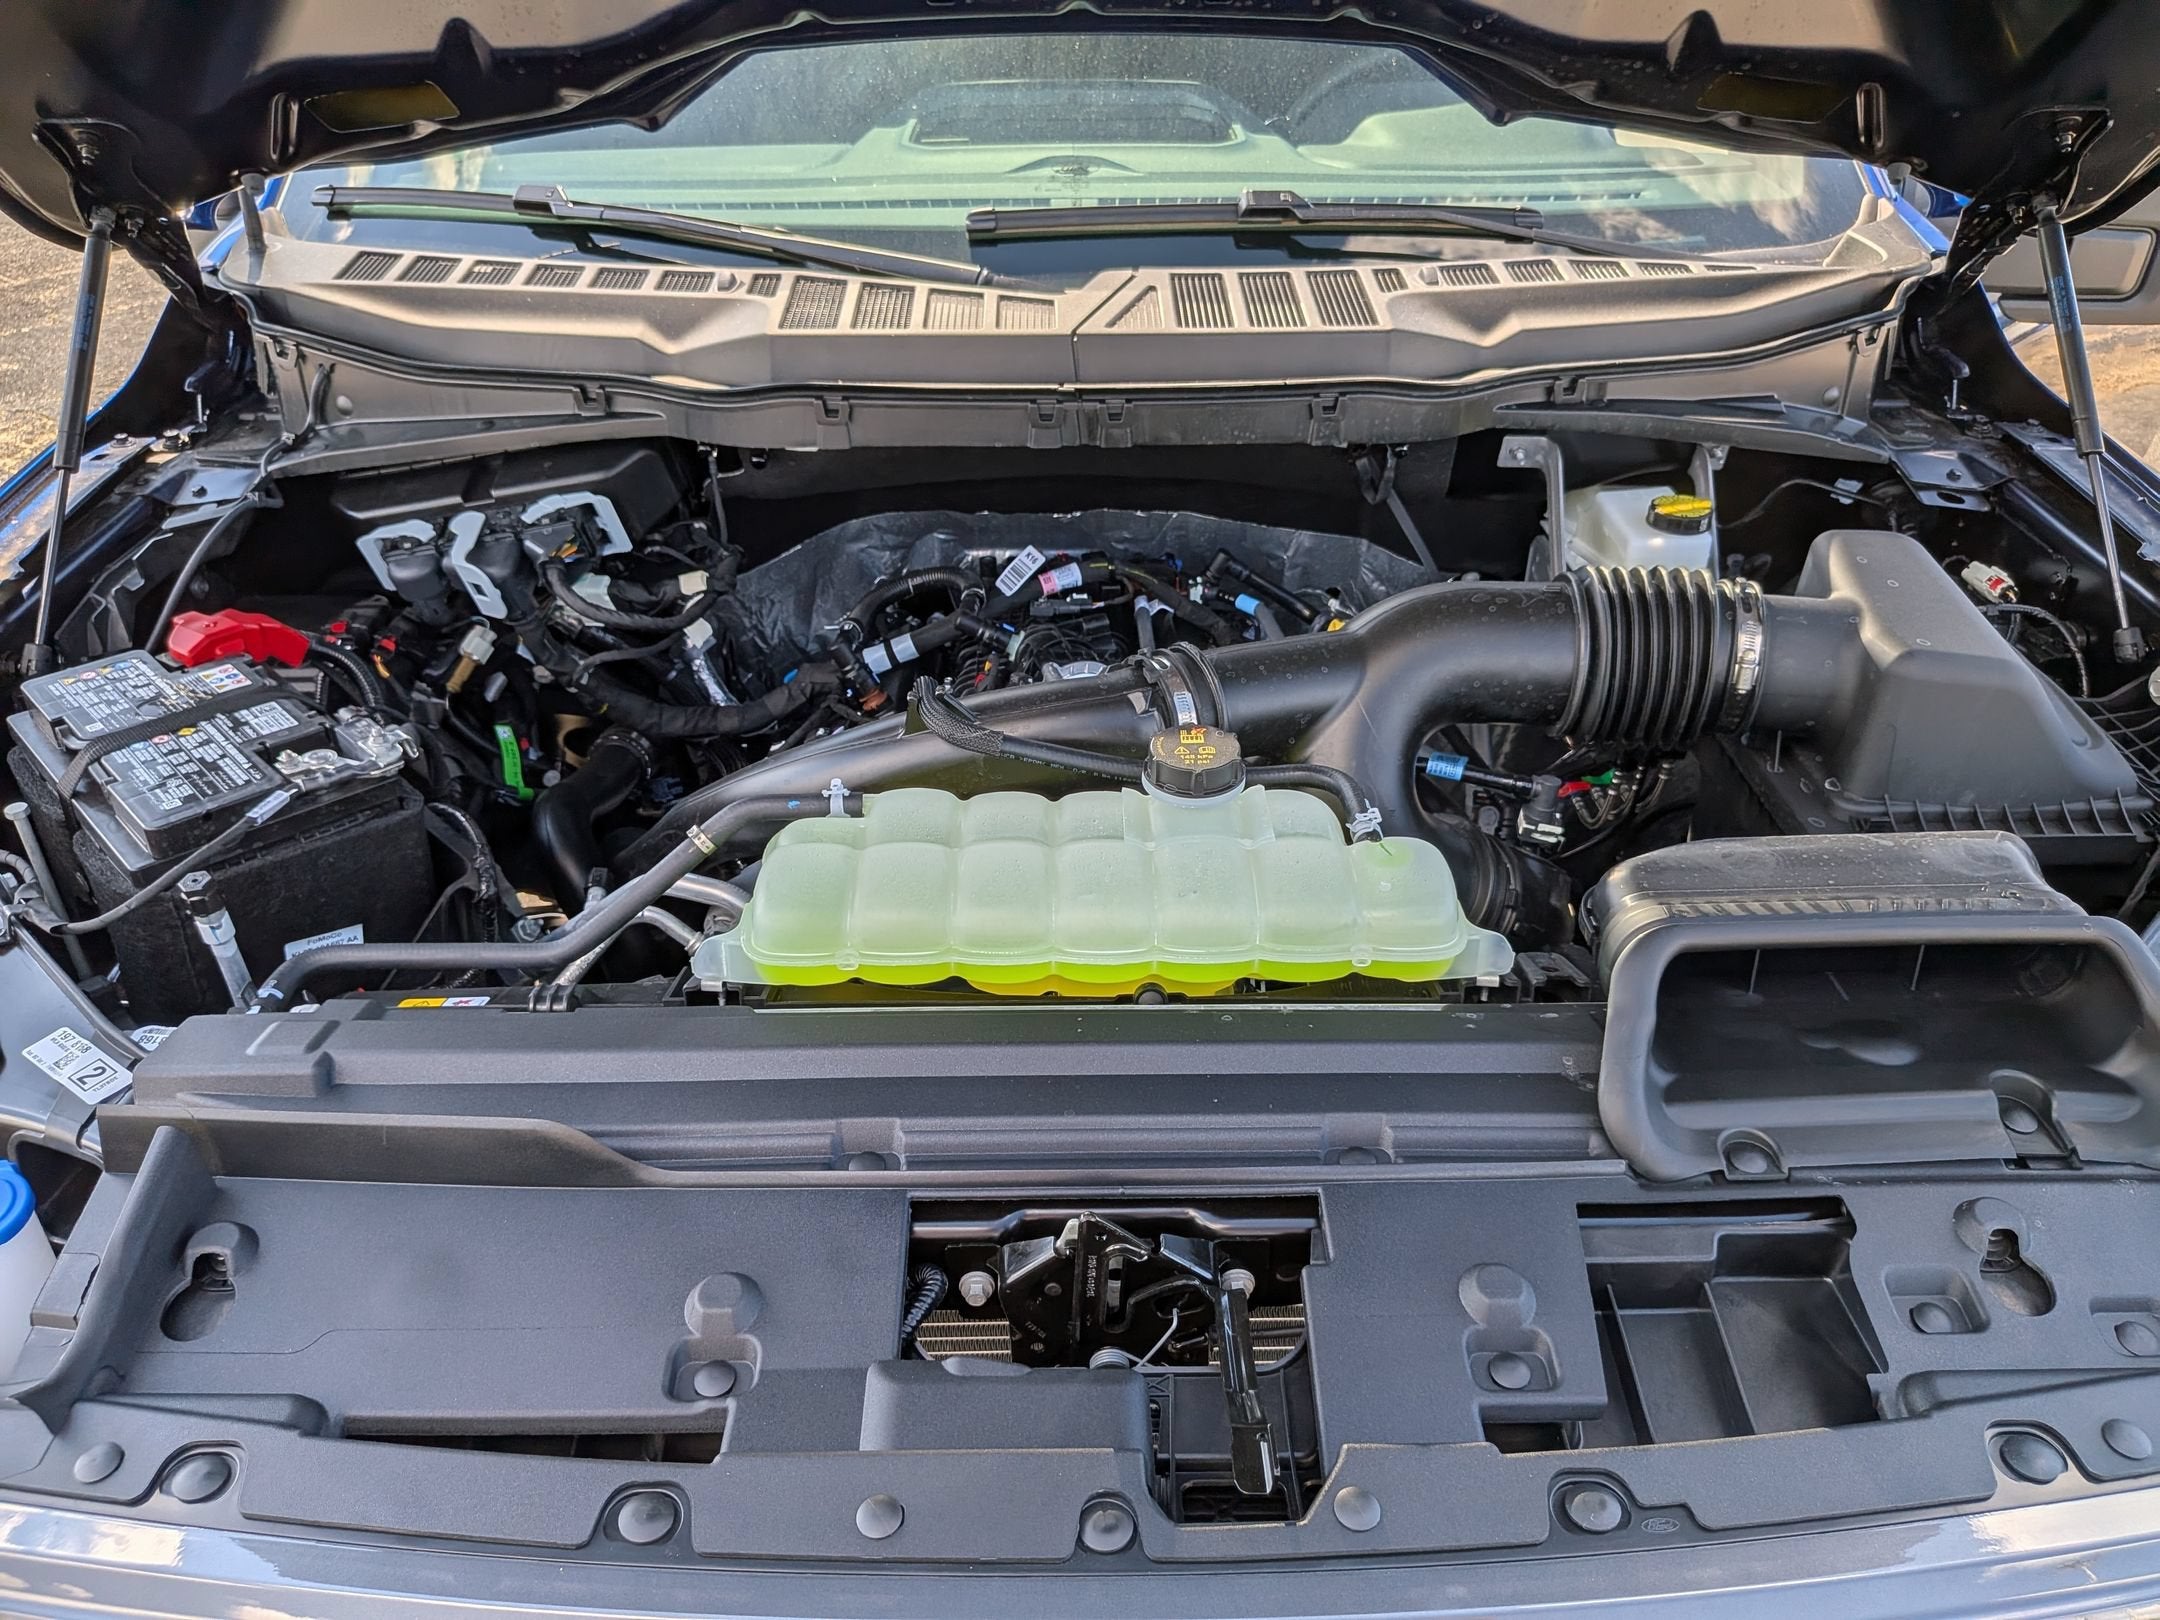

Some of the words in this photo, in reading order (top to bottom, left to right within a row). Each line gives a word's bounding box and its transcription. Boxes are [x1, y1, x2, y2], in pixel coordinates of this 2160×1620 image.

[1024, 551, 1039, 565] K16
[57, 1029, 76, 1044] 197
[76, 1065, 107, 1086] 2
